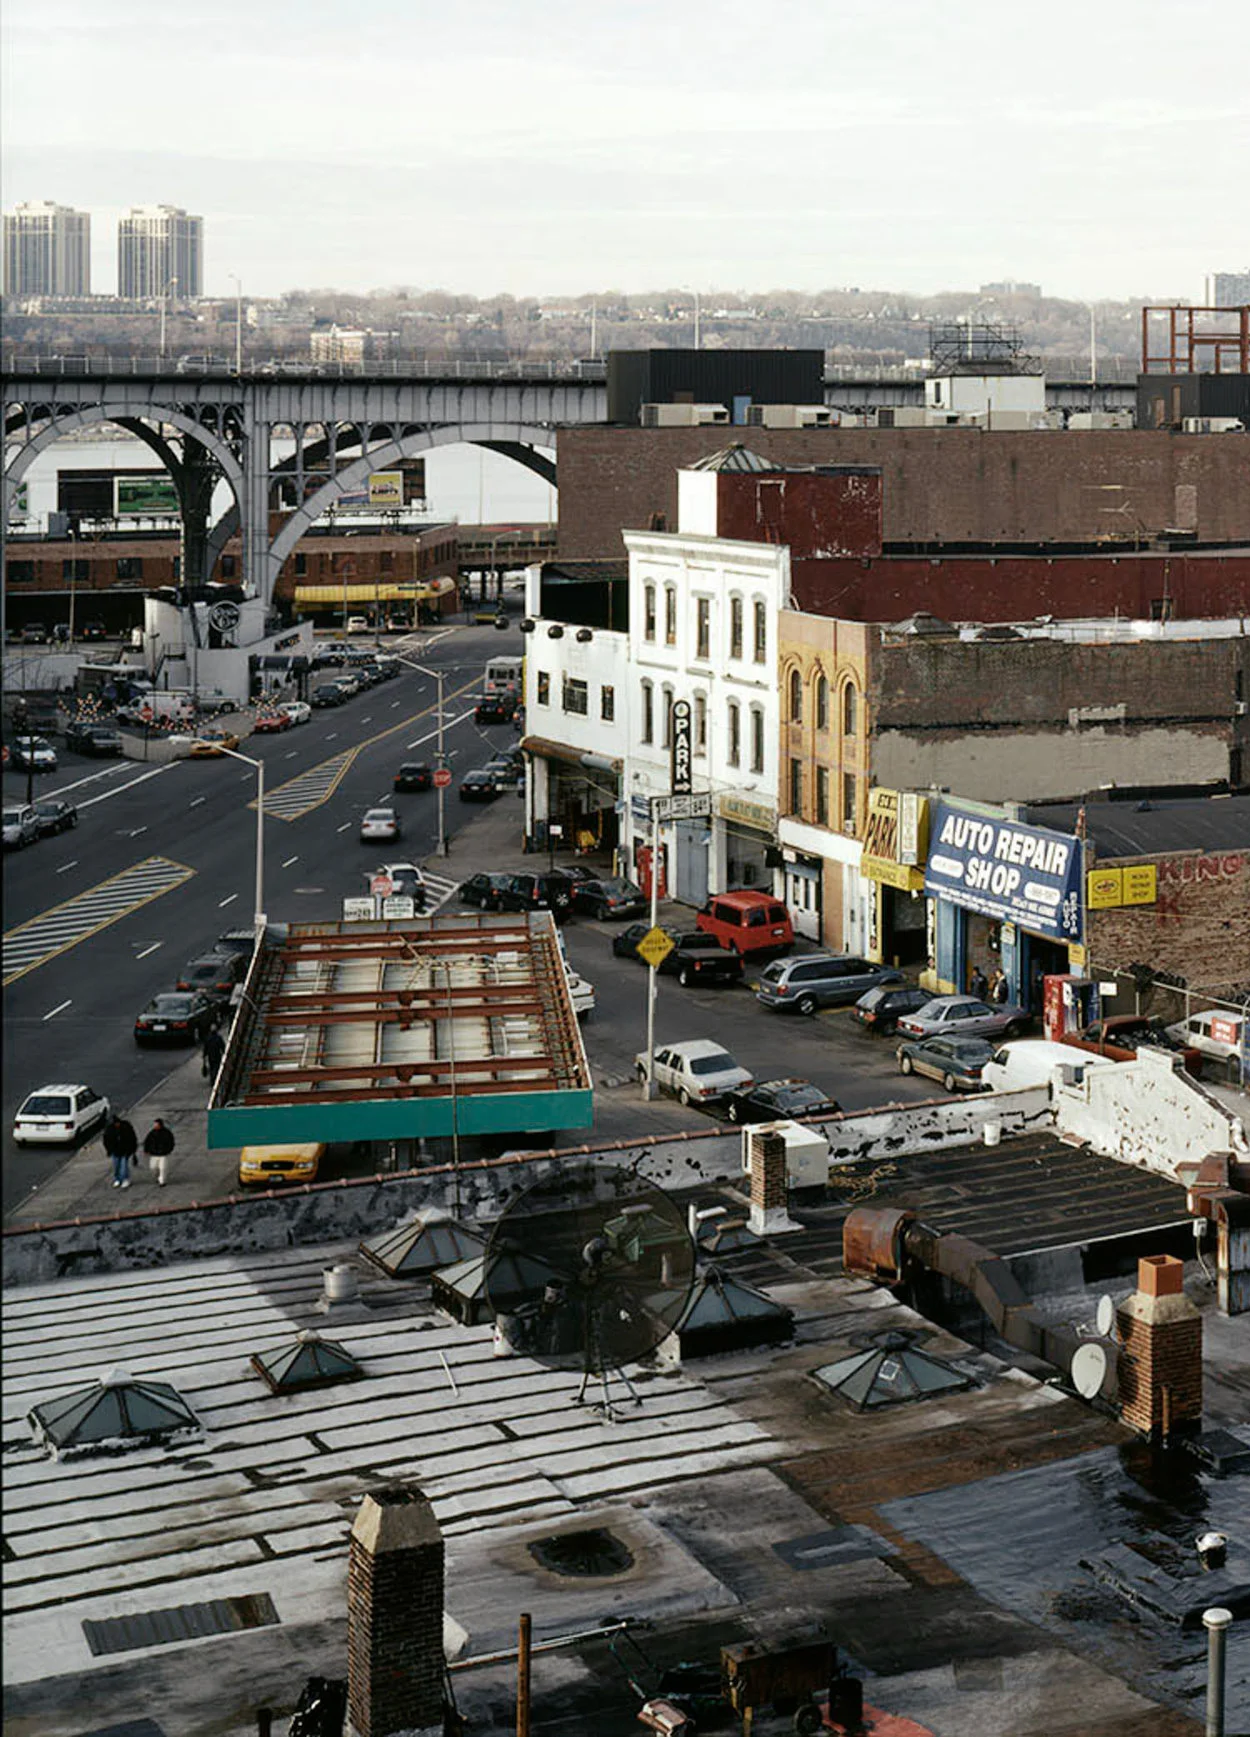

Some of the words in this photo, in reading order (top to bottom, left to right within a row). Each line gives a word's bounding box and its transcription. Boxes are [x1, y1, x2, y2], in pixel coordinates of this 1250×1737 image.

[676, 719, 689, 779] PARK
[940, 815, 994, 855] AUTO
[994, 825, 1069, 876] REPAIR
[964, 857, 1021, 898] SHOP
